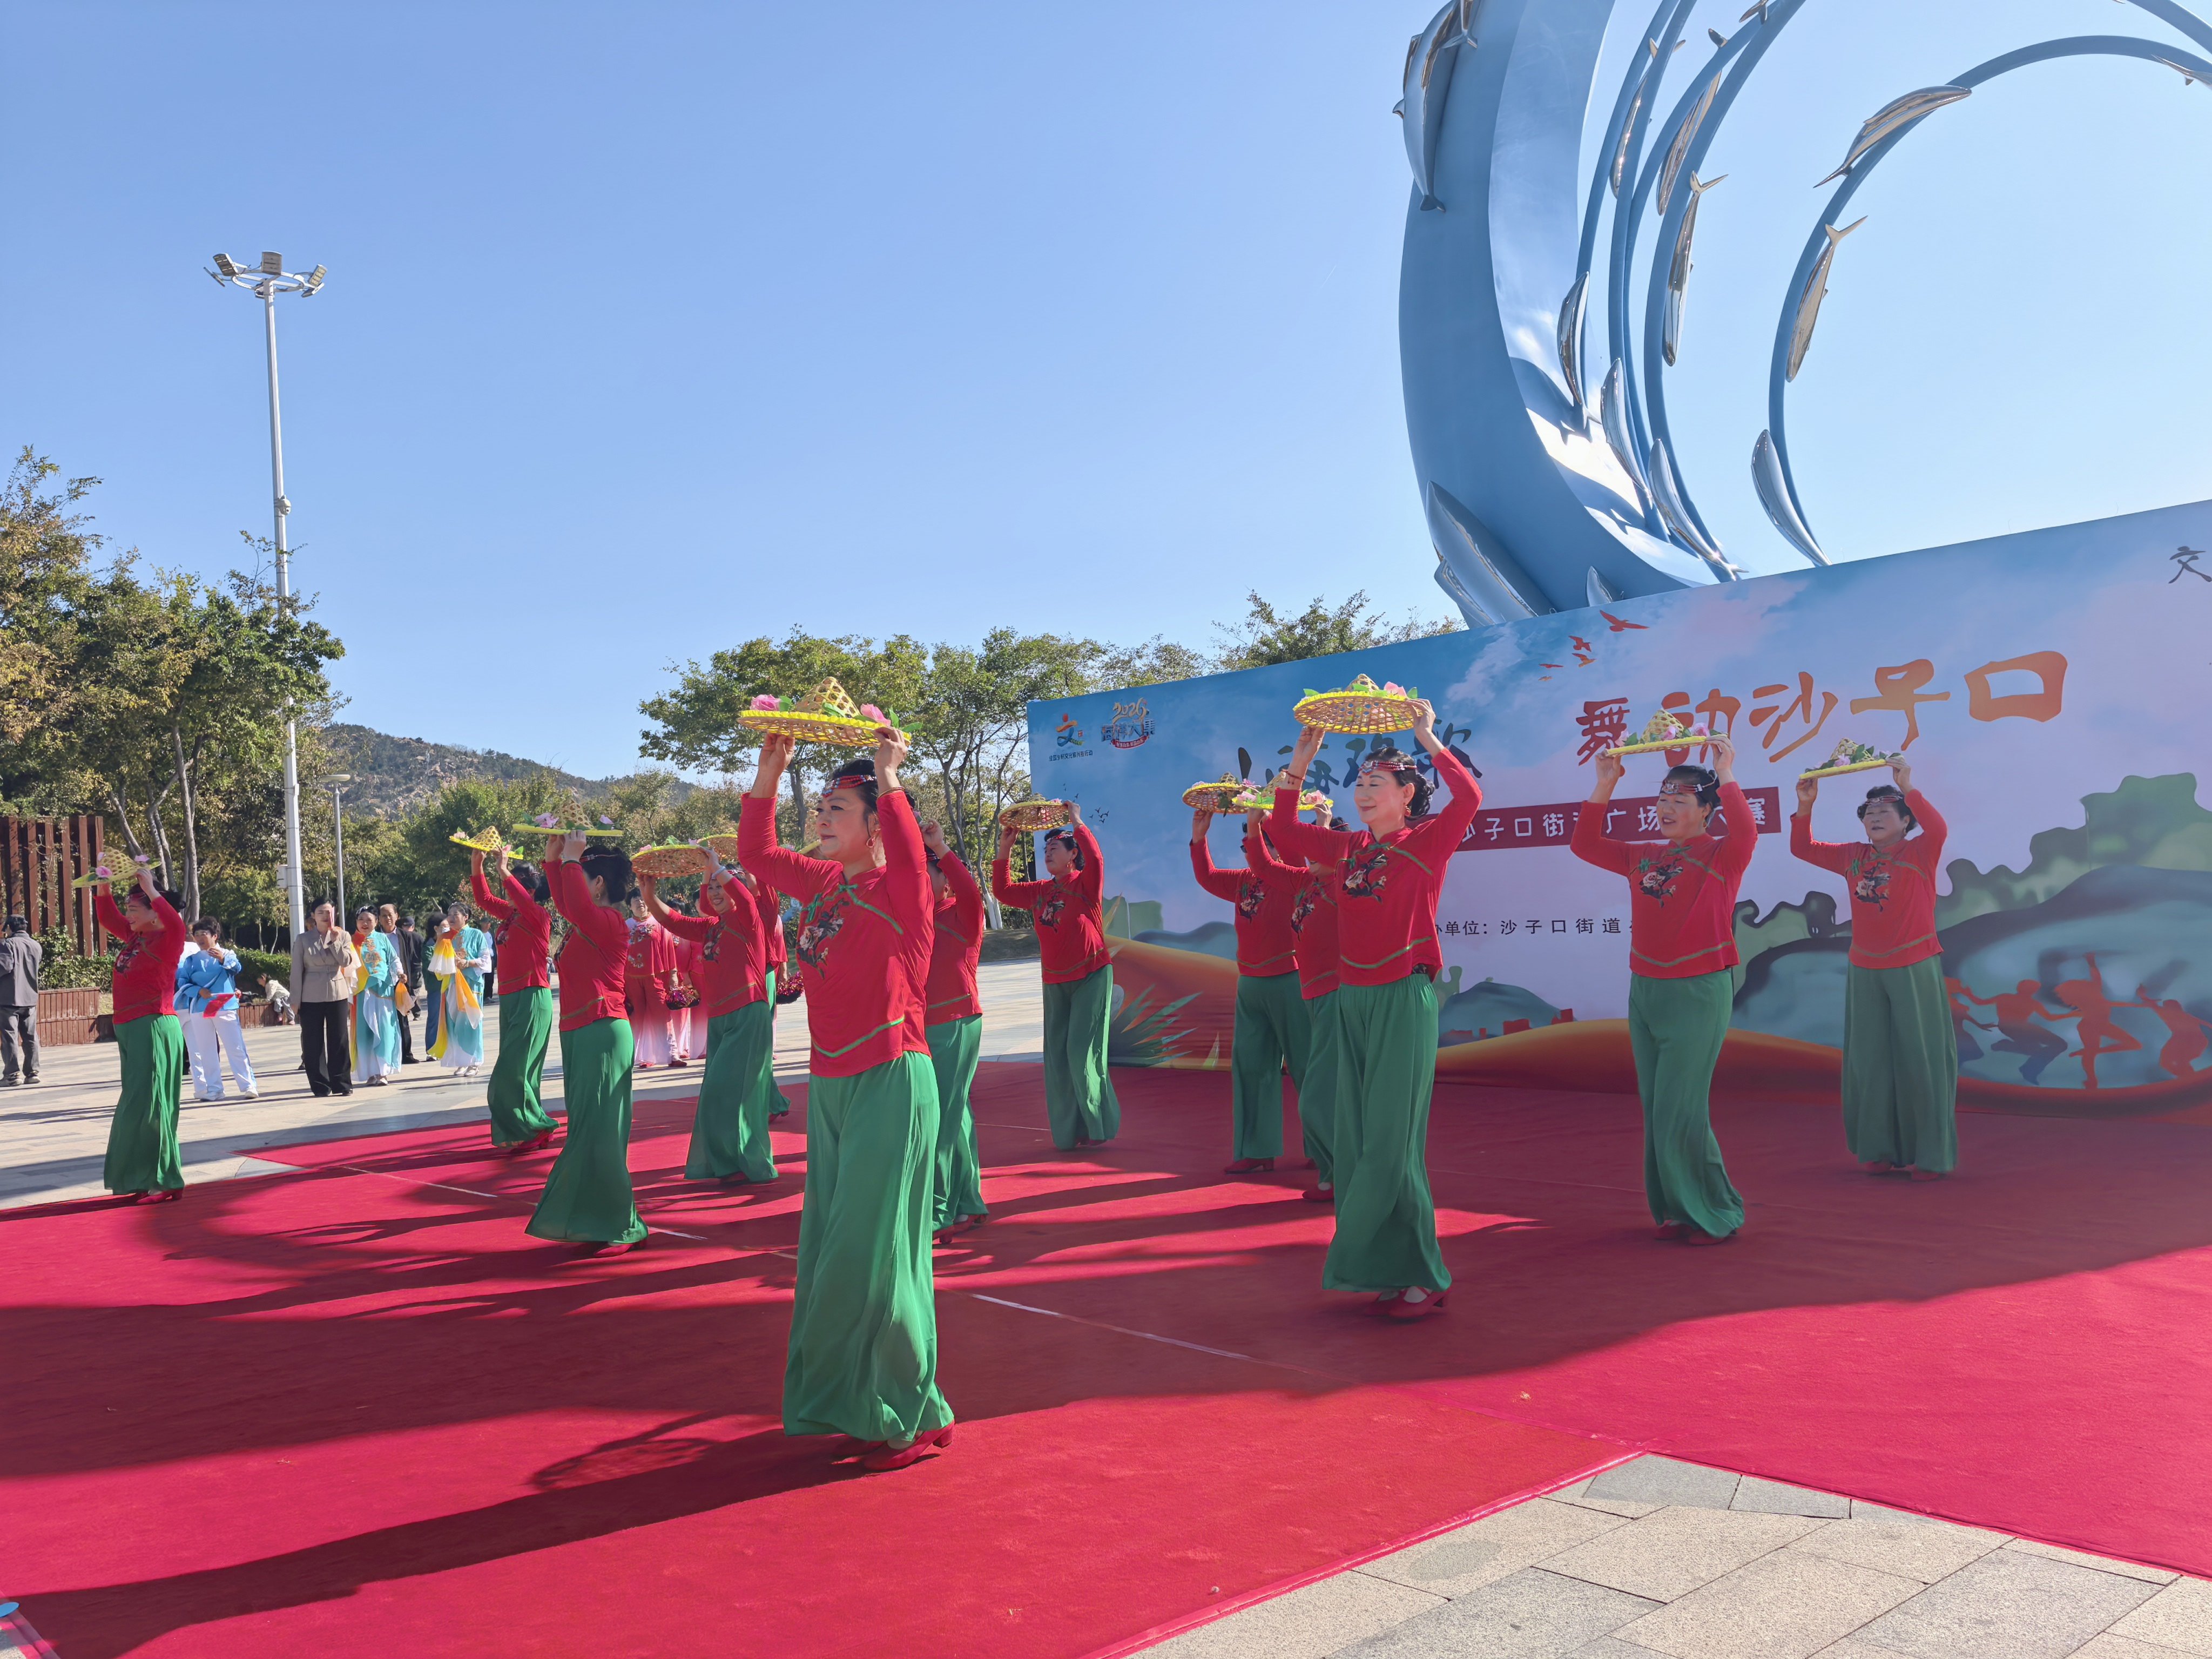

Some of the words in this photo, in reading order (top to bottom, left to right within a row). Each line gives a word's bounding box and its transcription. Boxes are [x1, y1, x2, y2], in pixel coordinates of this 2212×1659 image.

[2168, 545, 2212, 584] 交
[1435, 918, 1632, 936] 单位：沙子口街道
